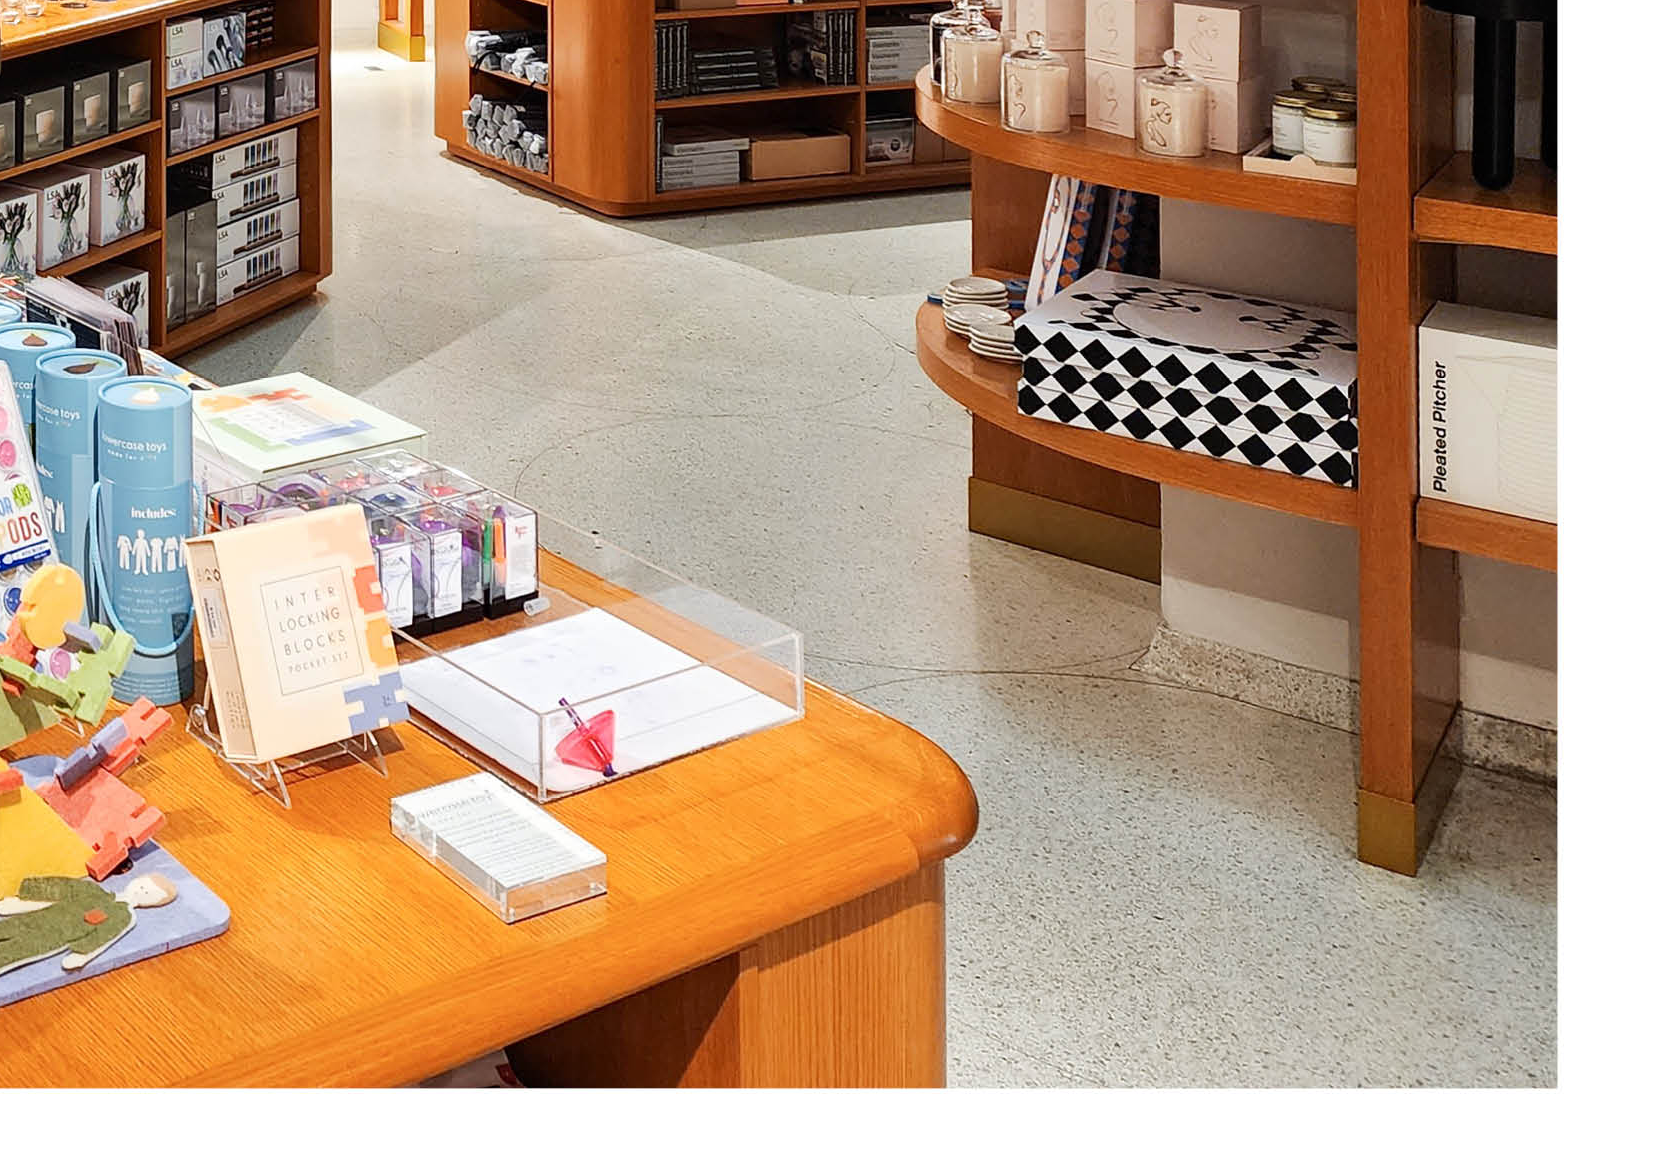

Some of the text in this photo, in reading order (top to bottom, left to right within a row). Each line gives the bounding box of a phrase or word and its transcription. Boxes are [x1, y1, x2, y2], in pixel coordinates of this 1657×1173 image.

[214, 153, 227, 164] LSA
[46, 189, 61, 202] LSA
[60, 408, 81, 421] toys
[1432, 360, 1447, 493] Pleated Pitcher
[145, 441, 168, 456] toys
[274, 585, 335, 610] INTER
[279, 606, 340, 633] LOCKING
[284, 629, 346, 656] BLOCKS
